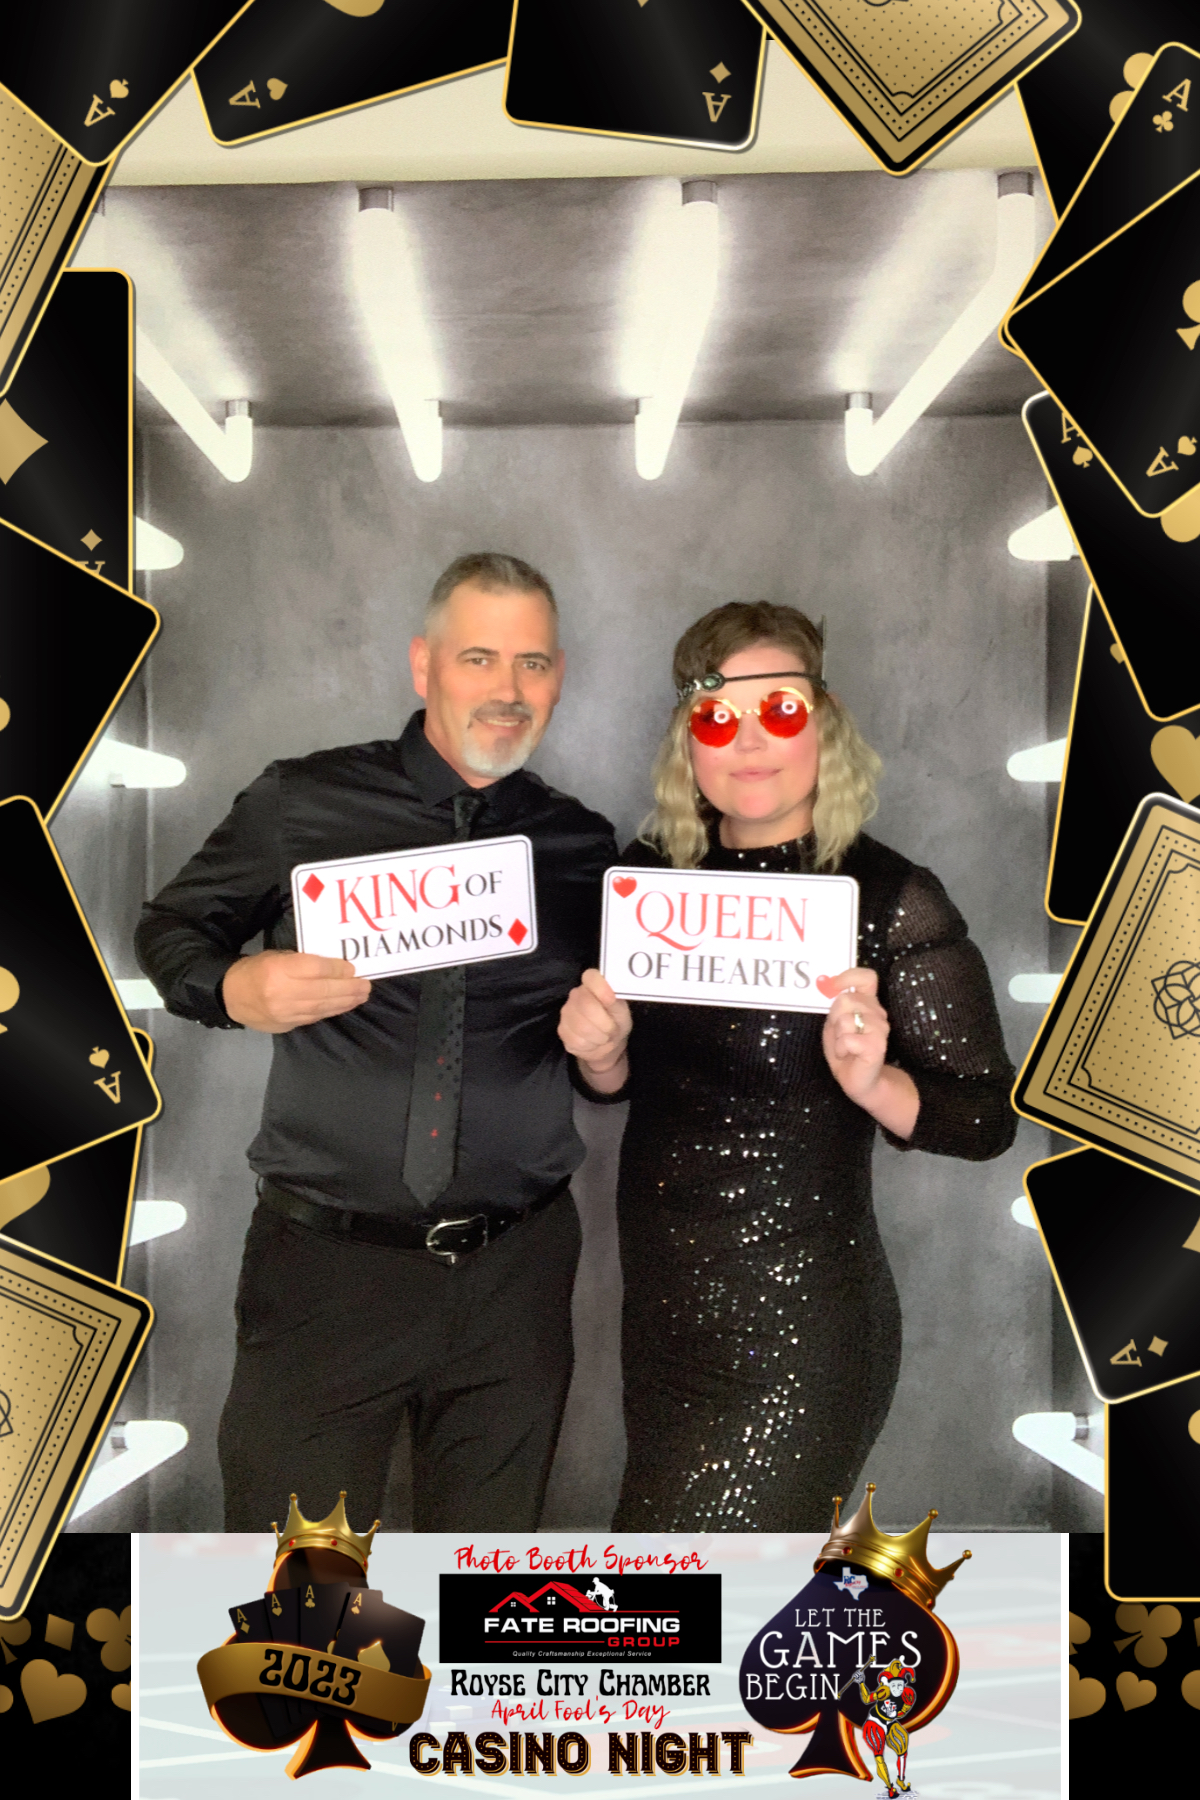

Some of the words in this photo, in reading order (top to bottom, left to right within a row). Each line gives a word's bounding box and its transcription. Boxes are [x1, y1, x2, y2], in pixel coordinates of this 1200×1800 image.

[335, 864, 461, 932] KING
[465, 870, 503, 897] OF
[636, 891, 809, 951] QUEEN
[340, 915, 503, 962] DIAMONDS
[628, 951, 672, 979] OF
[681, 954, 811, 989] HEARTS
